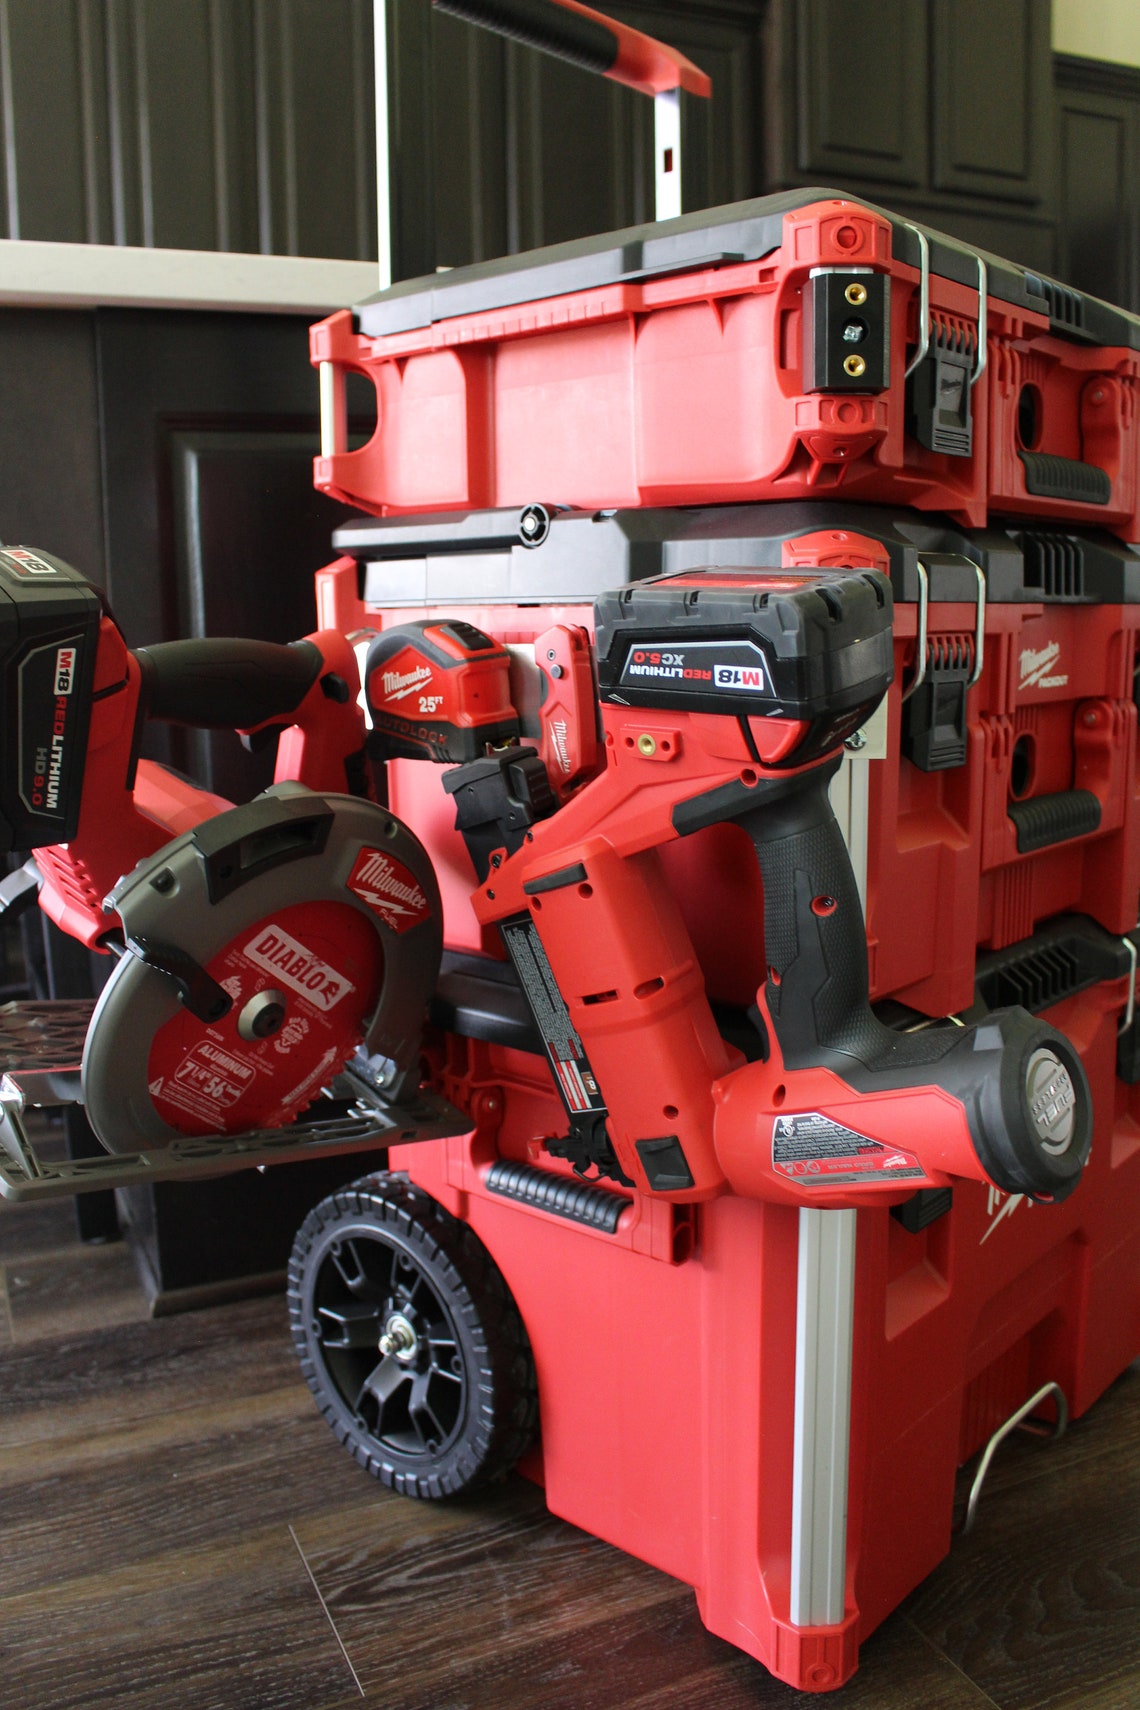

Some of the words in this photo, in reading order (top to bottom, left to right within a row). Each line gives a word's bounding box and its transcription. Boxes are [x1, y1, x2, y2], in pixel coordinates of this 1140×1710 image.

[5, 551, 50, 571] M18
[57, 650, 73, 692] M18
[629, 664, 713, 681] REDLITHIUM
[633, 651, 685, 666] XC5.0
[381, 665, 432, 694] Milwaukee
[718, 669, 760, 686] M18
[46, 696, 67, 809] REDLITHIUM
[553, 718, 572, 774] Milwaukee
[355, 852, 427, 909] Milwaukee
[254, 933, 327, 991] DIABLO
[197, 1044, 253, 1080] ALUMINUM
[202, 1076, 228, 1098] 56
